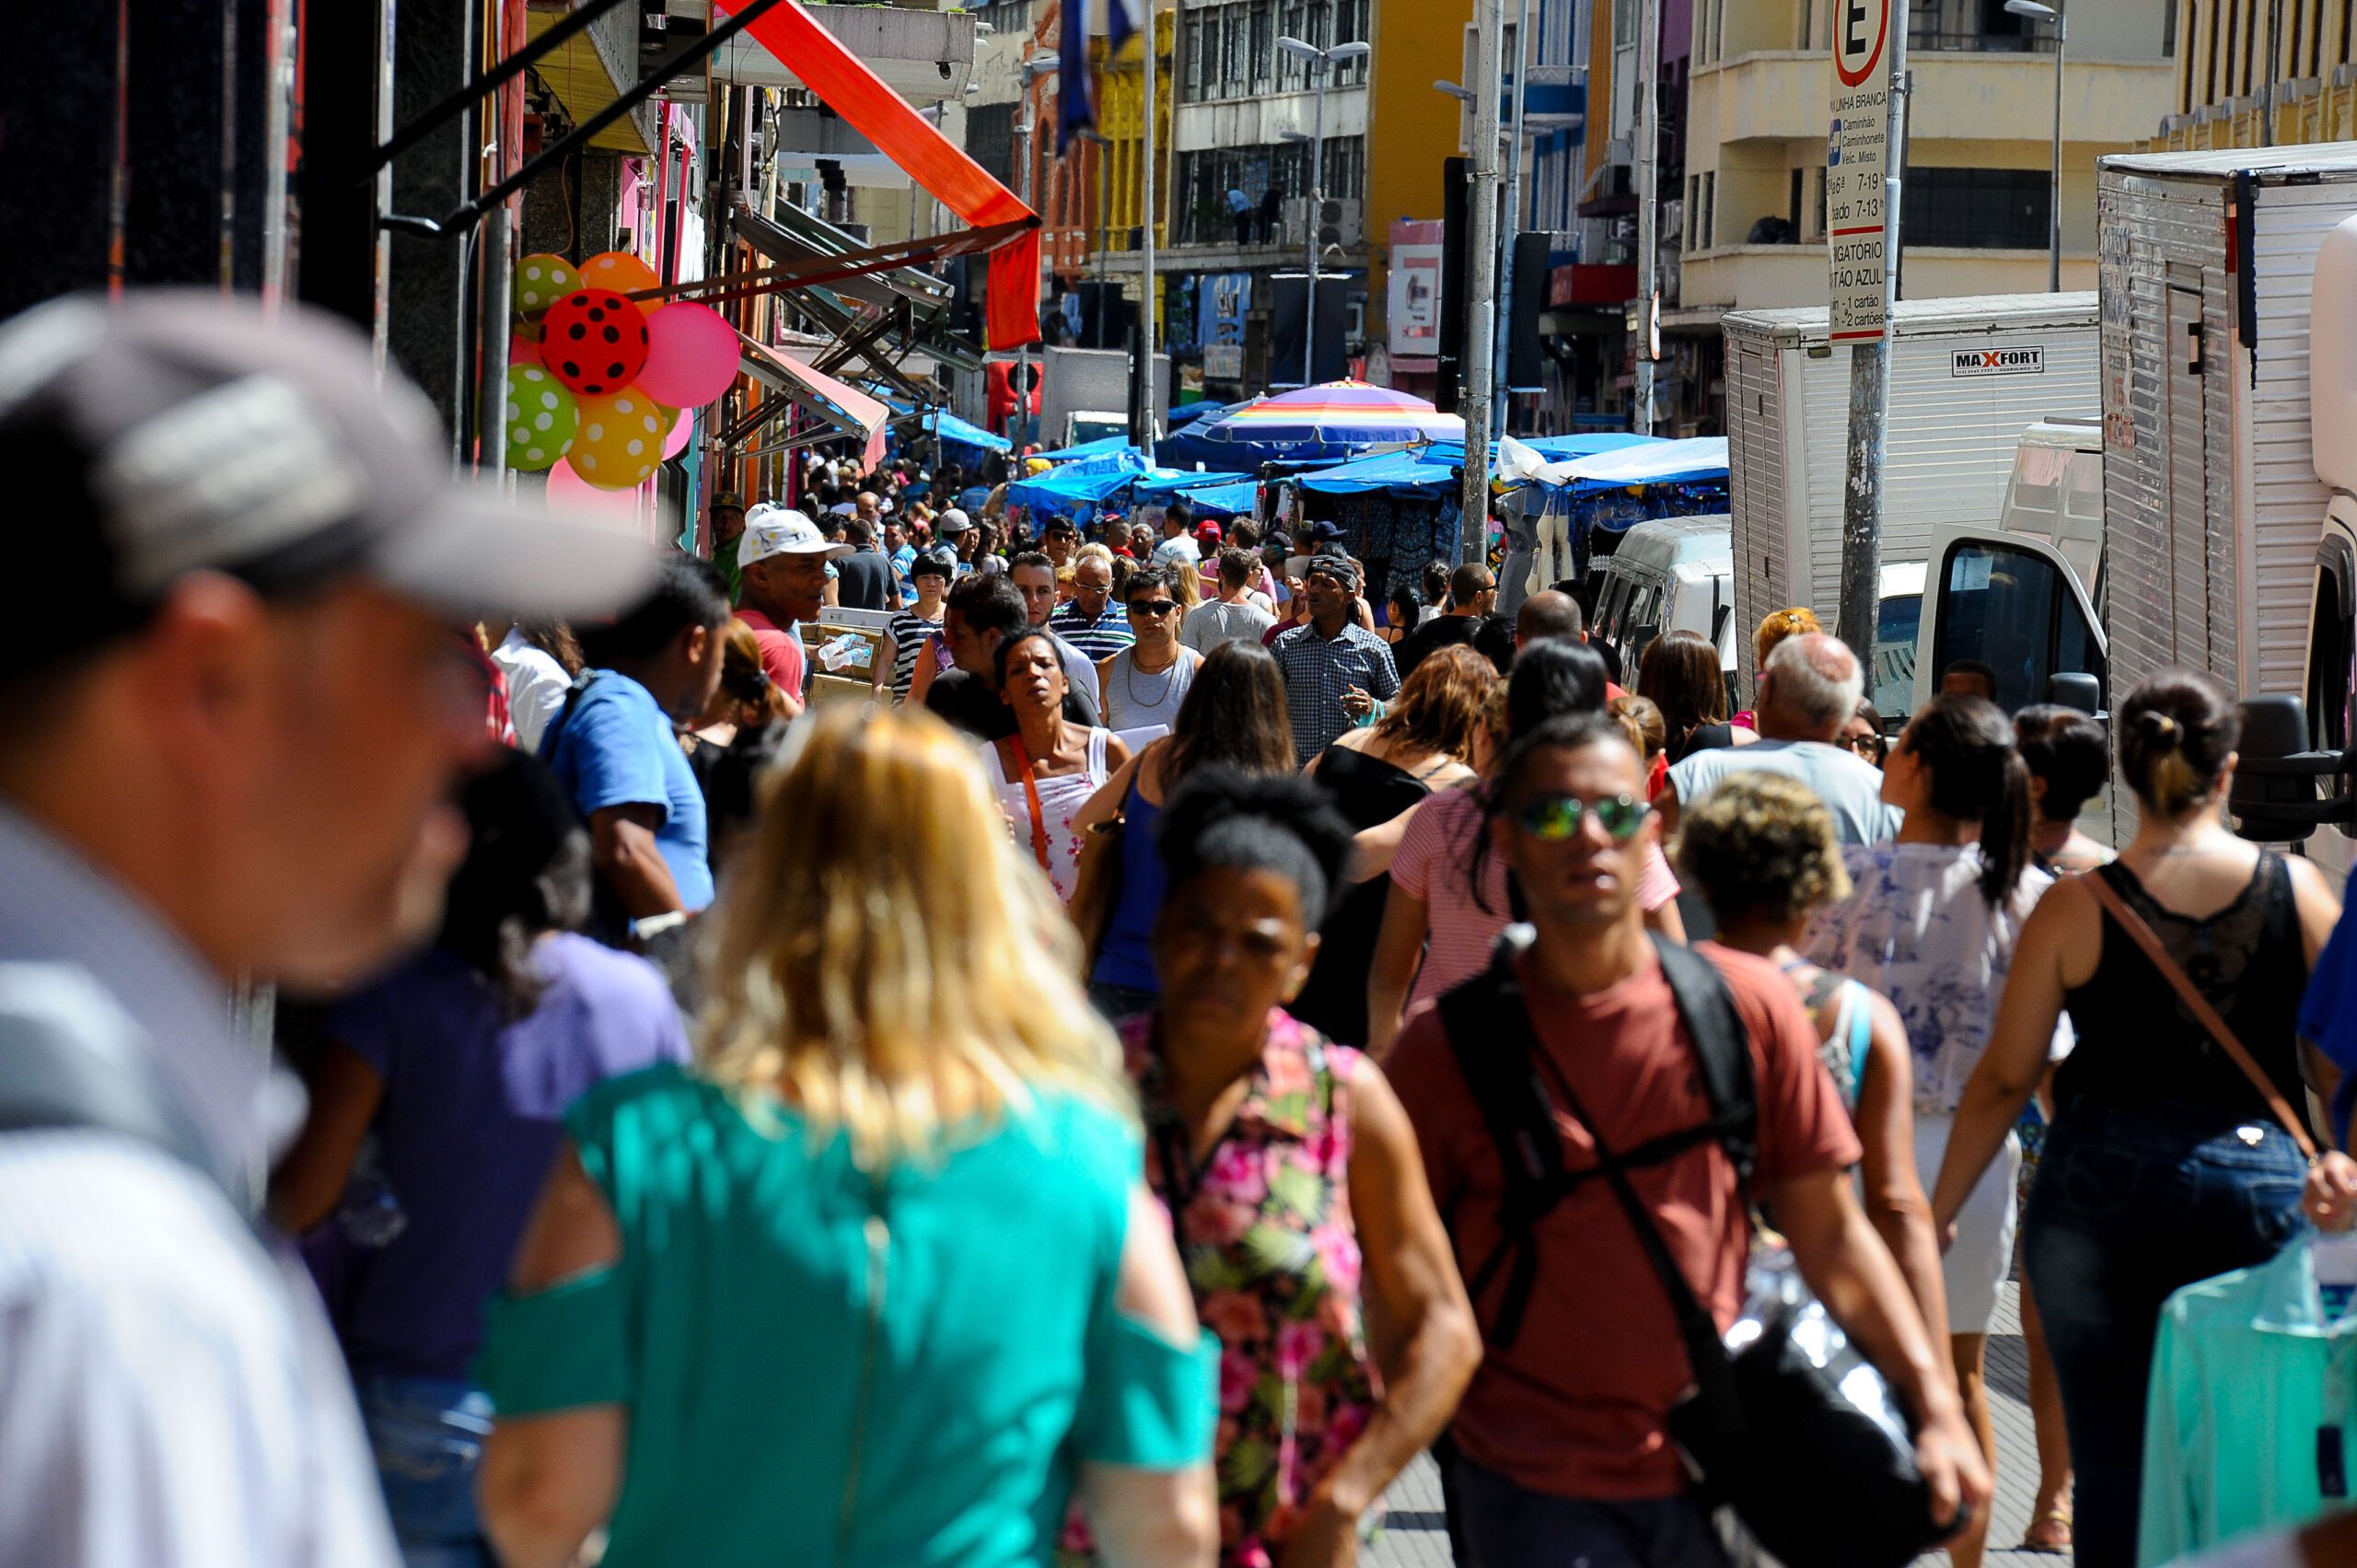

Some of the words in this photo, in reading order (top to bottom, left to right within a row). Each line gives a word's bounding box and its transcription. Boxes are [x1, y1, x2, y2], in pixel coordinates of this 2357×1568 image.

[1845, 0, 1866, 55] E
[1855, 91, 1887, 109] BRANCA
[1842, 115, 1875, 131] Caminhão
[1841, 133, 1885, 147] Caminhonete
[1859, 150, 1876, 163] Misto
[1855, 268, 1883, 286] AZUL
[1853, 294, 1879, 308] cartão
[1847, 313, 1852, 327] 2
[1854, 311, 1884, 327] cartões
[1956, 351, 2040, 367] MAXFORT
